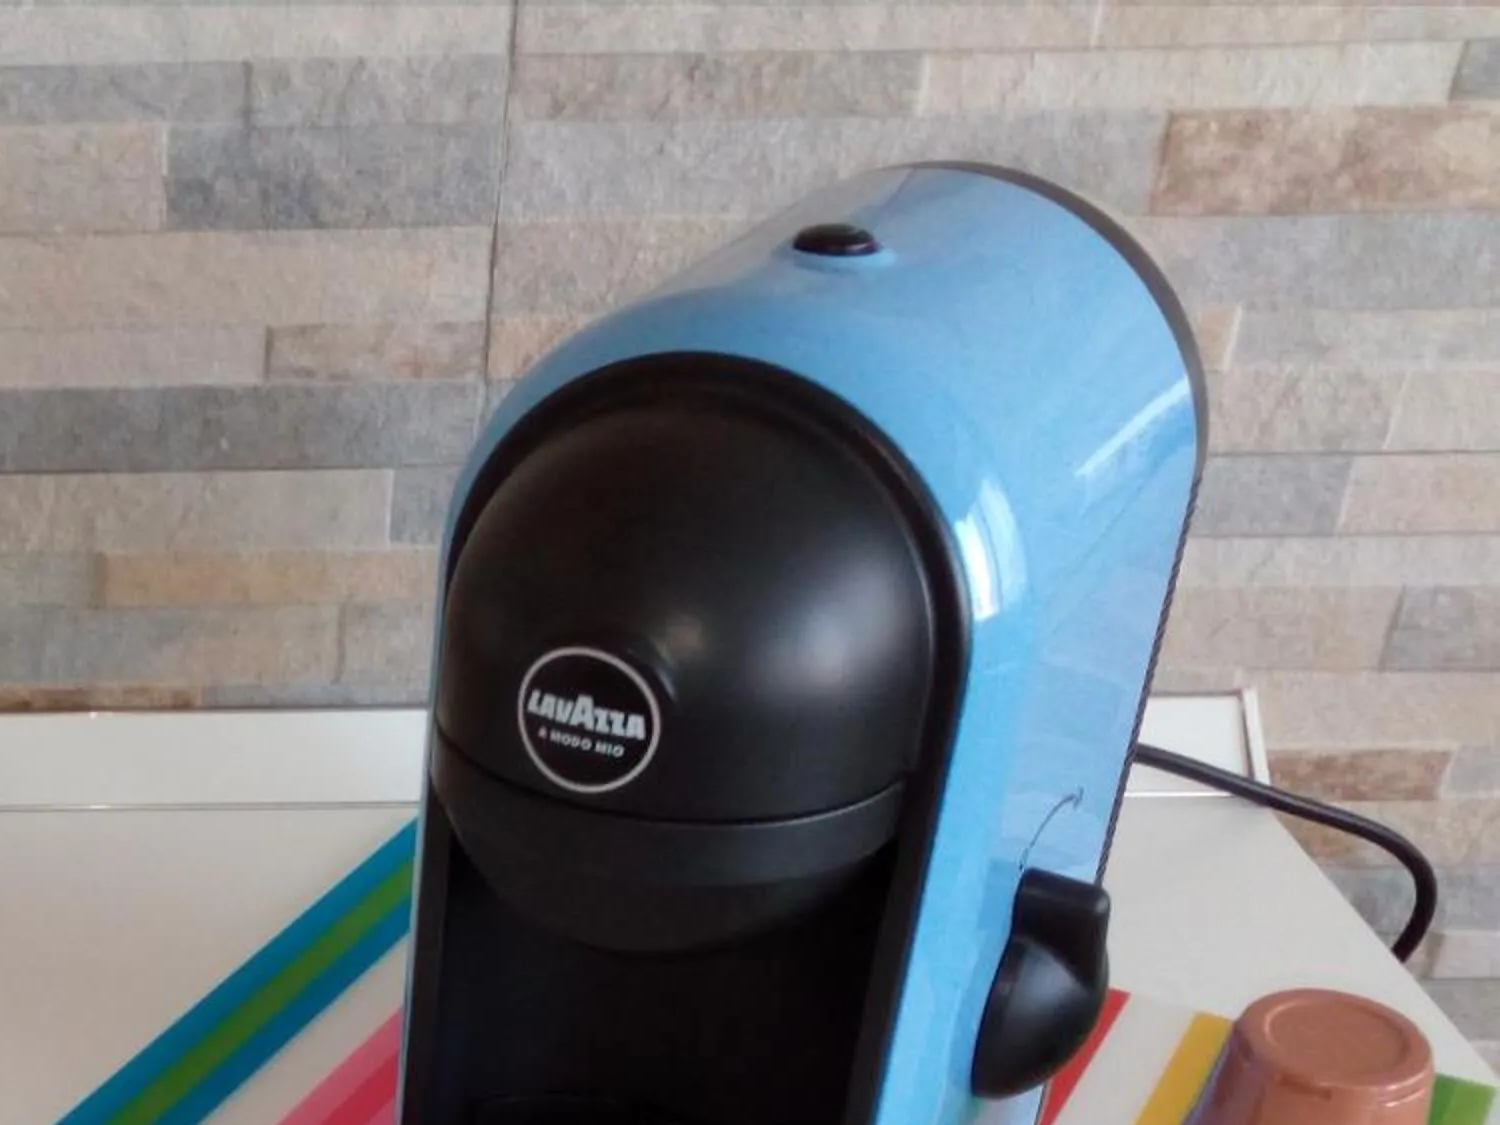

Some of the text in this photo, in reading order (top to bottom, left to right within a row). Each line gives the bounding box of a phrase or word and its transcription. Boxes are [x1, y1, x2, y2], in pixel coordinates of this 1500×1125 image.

[527, 689, 646, 740] LAVAZZA
[551, 730, 592, 750] MODO
[595, 740, 625, 758] MIO
